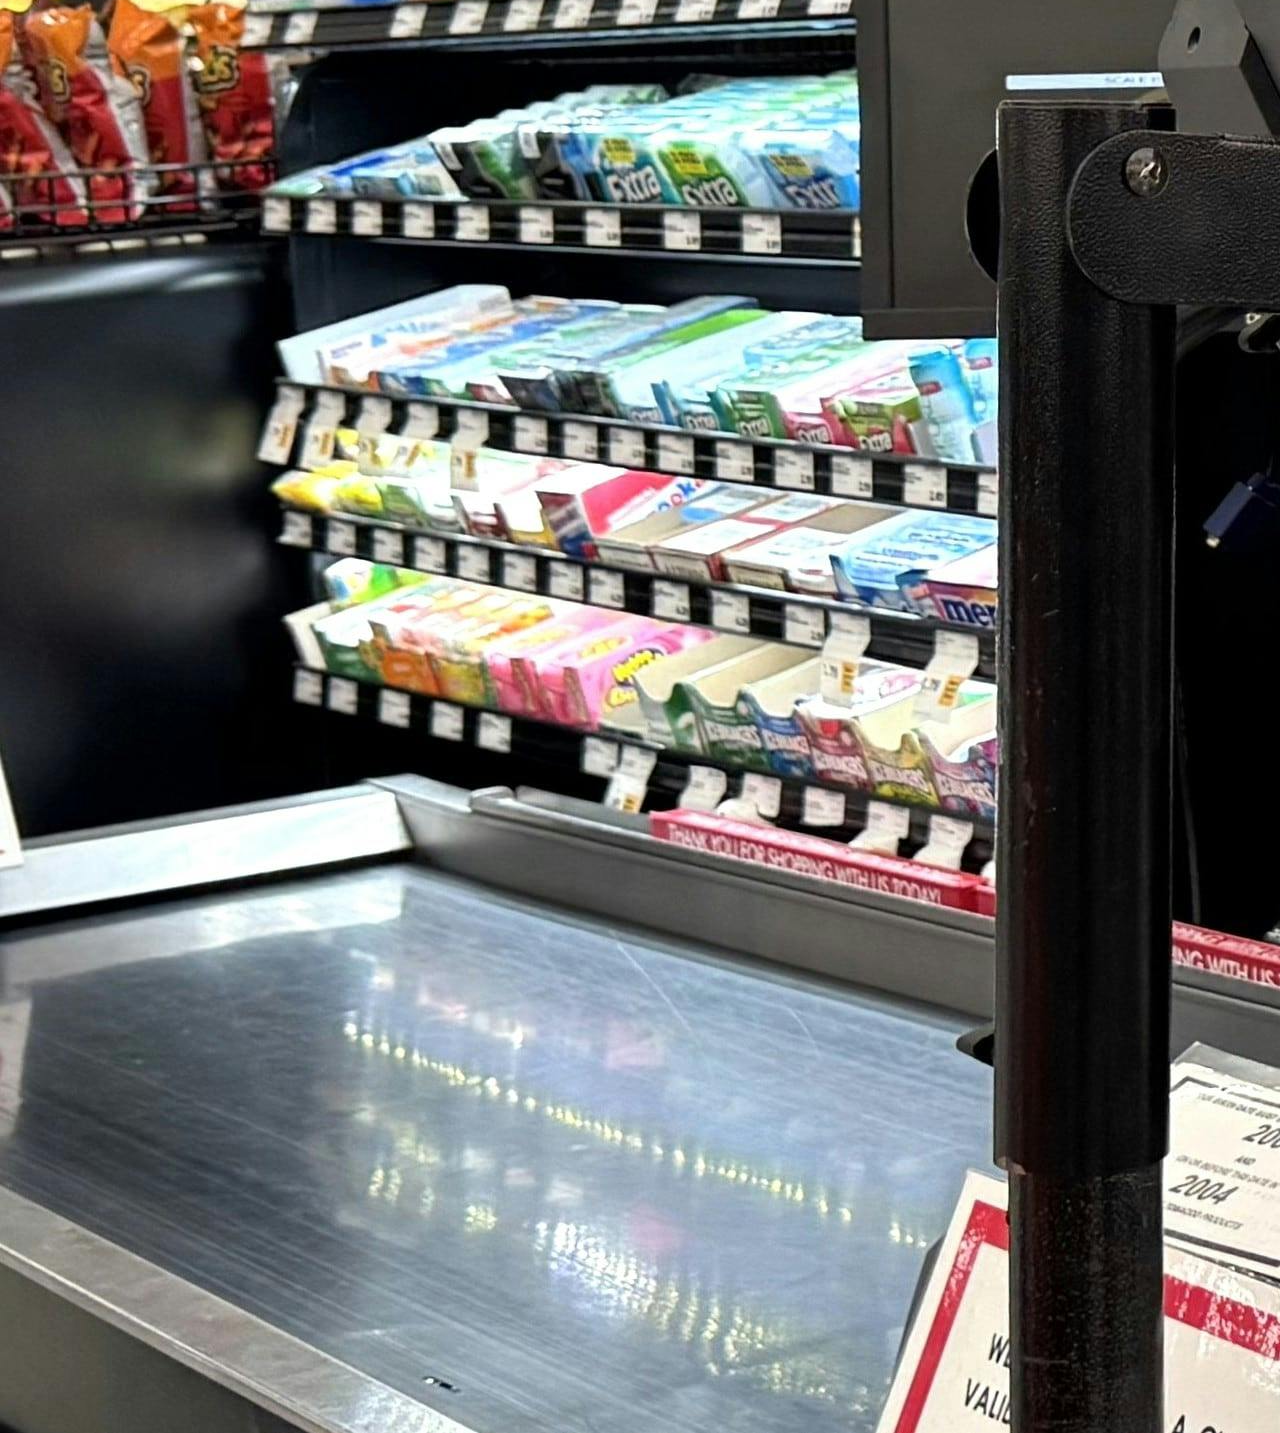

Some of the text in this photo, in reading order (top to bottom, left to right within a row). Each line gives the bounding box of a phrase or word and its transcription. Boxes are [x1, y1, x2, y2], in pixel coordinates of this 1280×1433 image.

[607, 165, 661, 203] Extra
[668, 822, 710, 851] THANK
[711, 831, 739, 856] YOU
[740, 837, 766, 864] FOR
[767, 845, 836, 880] SHOPPING
[834, 861, 871, 890] WITH
[872, 870, 888, 893] US
[1205, 954, 1250, 979] WITH
[1251, 966, 1274, 986] US
[1233, 1155, 1256, 1166] AND
[1168, 1173, 1239, 1204] 2004
